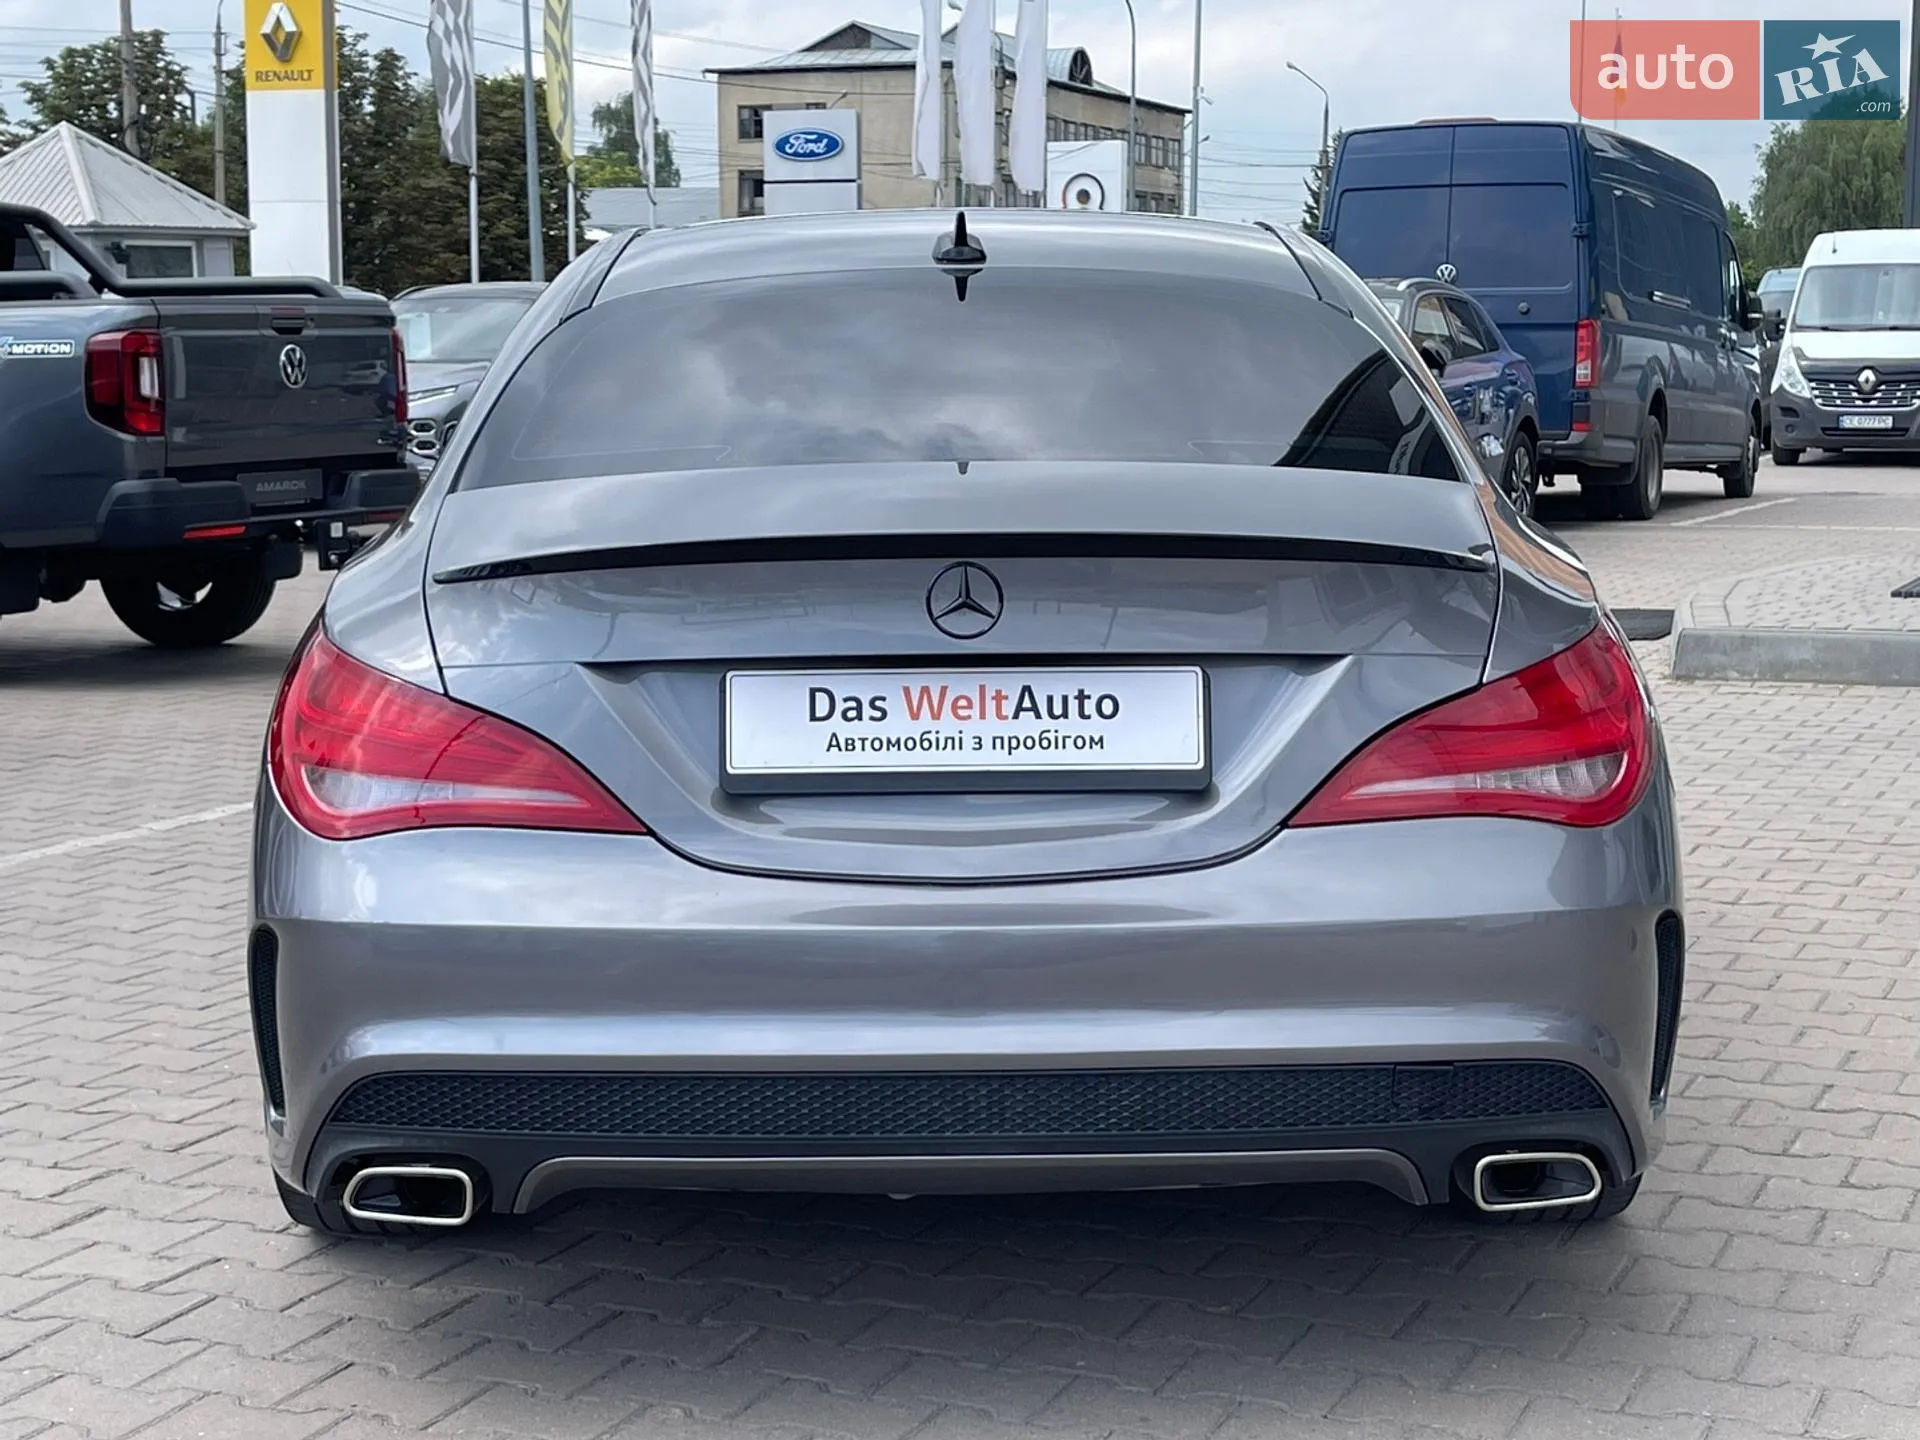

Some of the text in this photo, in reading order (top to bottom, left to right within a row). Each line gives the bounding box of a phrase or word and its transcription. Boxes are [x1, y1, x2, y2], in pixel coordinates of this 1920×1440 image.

[255, 69, 315, 82] RENAULT
[785, 133, 828, 154] Ford
[255, 480, 307, 492] AMAROK
[808, 684, 1120, 722] Das WeltAuto
[826, 730, 1104, 755] Автомобілі з пробігом
